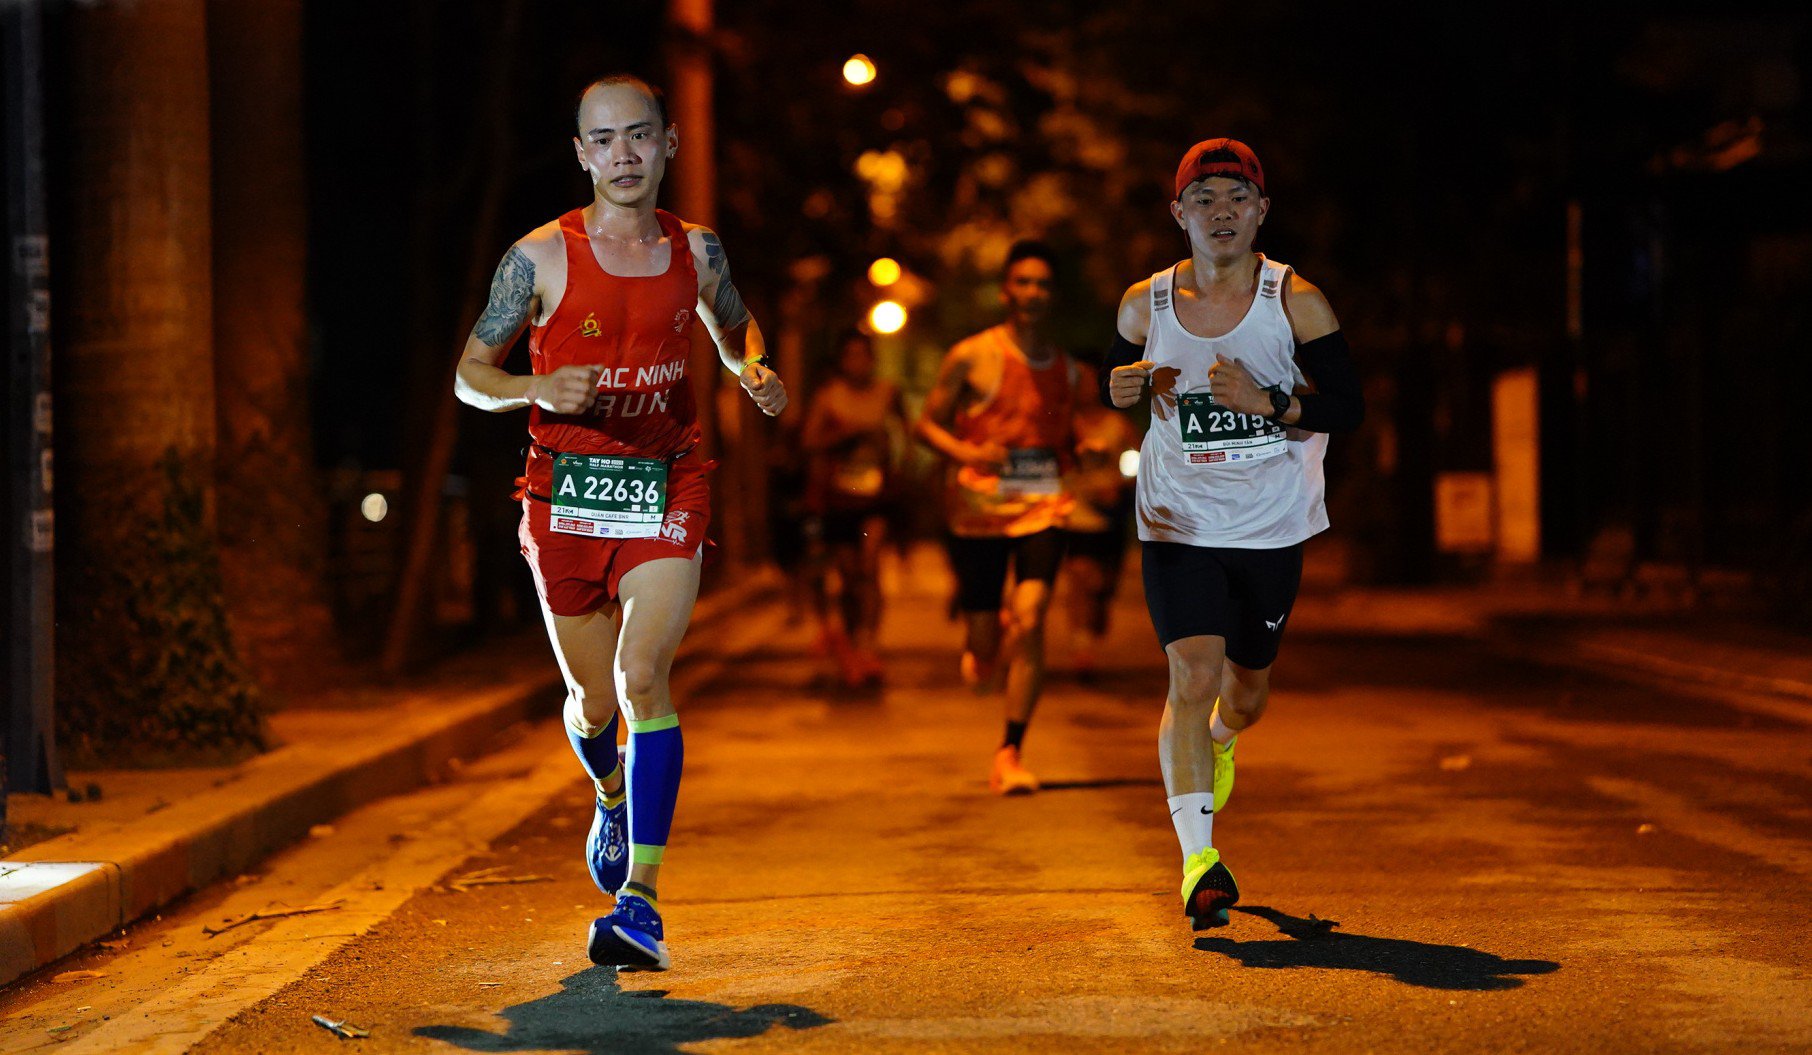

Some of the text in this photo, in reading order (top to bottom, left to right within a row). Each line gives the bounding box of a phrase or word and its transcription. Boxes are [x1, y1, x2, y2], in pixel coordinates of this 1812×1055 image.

[596, 359, 685, 388] AC NINH
[594, 389, 670, 418] RUN
[1186, 413, 1204, 434] A
[559, 474, 659, 504] A 22636
